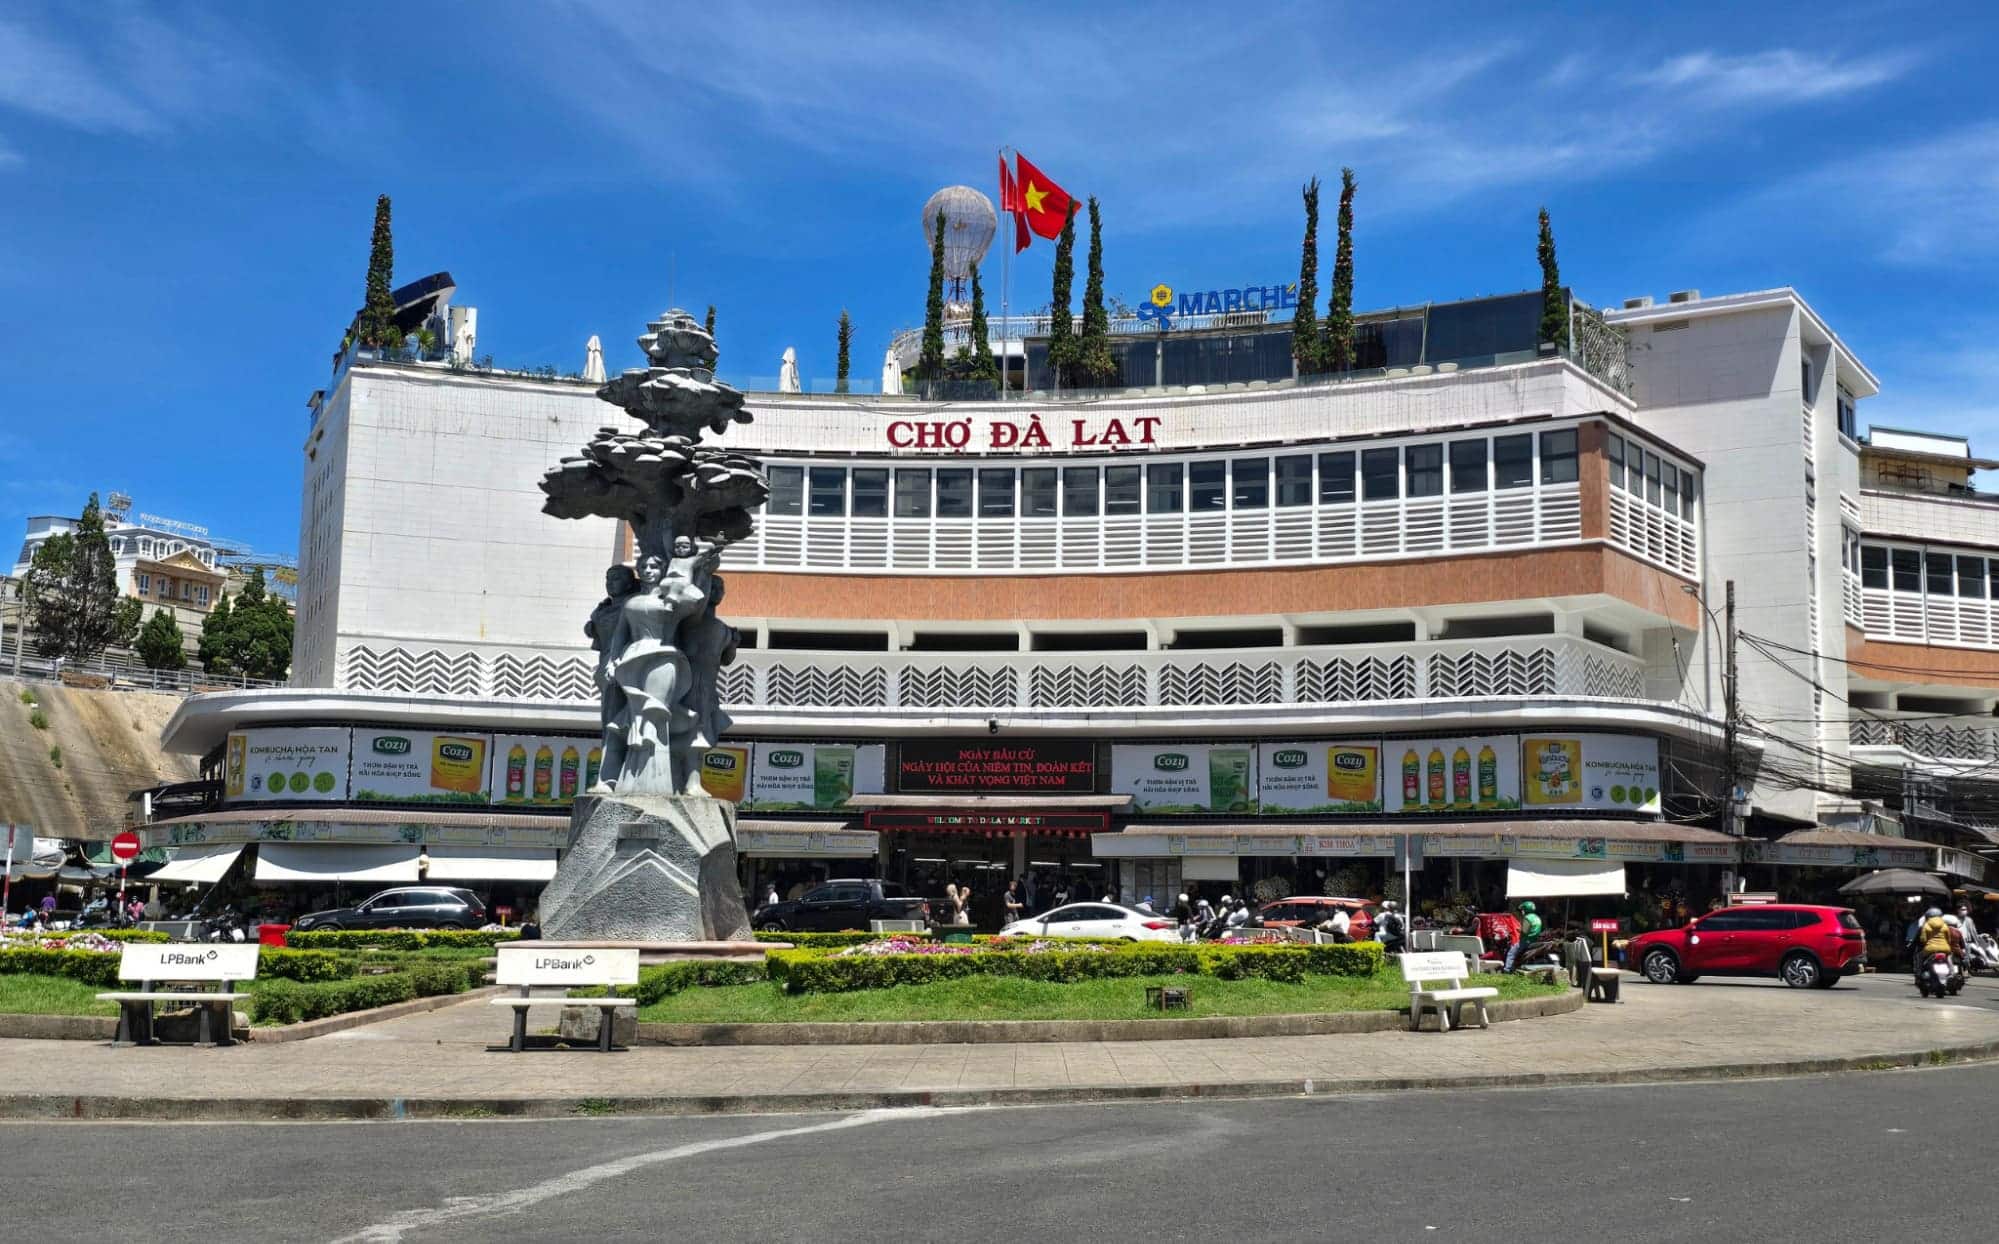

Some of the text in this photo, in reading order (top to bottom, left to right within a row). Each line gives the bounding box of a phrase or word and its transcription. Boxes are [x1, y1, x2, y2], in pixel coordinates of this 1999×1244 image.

[1179, 283, 1297, 317] MARCHÉ
[887, 413, 1161, 455] CHỢ ĐÀ LẠT
[318, 745, 338, 753] TAN
[375, 738, 408, 753] Cozy
[442, 745, 470, 759] Cozy
[706, 753, 733, 768] Cozy
[771, 751, 802, 766] Cozy
[959, 748, 990, 760] NGÀY
[1276, 752, 1304, 765] Cozy
[902, 760, 931, 773] NGÀY
[1157, 755, 1185, 769] Cozy
[1336, 755, 1363, 768] Cozy
[928, 774, 943, 785] VÀ
[978, 774, 1009, 788] VỌNG
[1012, 774, 1036, 787] VIỆT
[1040, 775, 1065, 785] NAM
[160, 953, 205, 965] LPBank
[535, 958, 583, 970] LPBank
